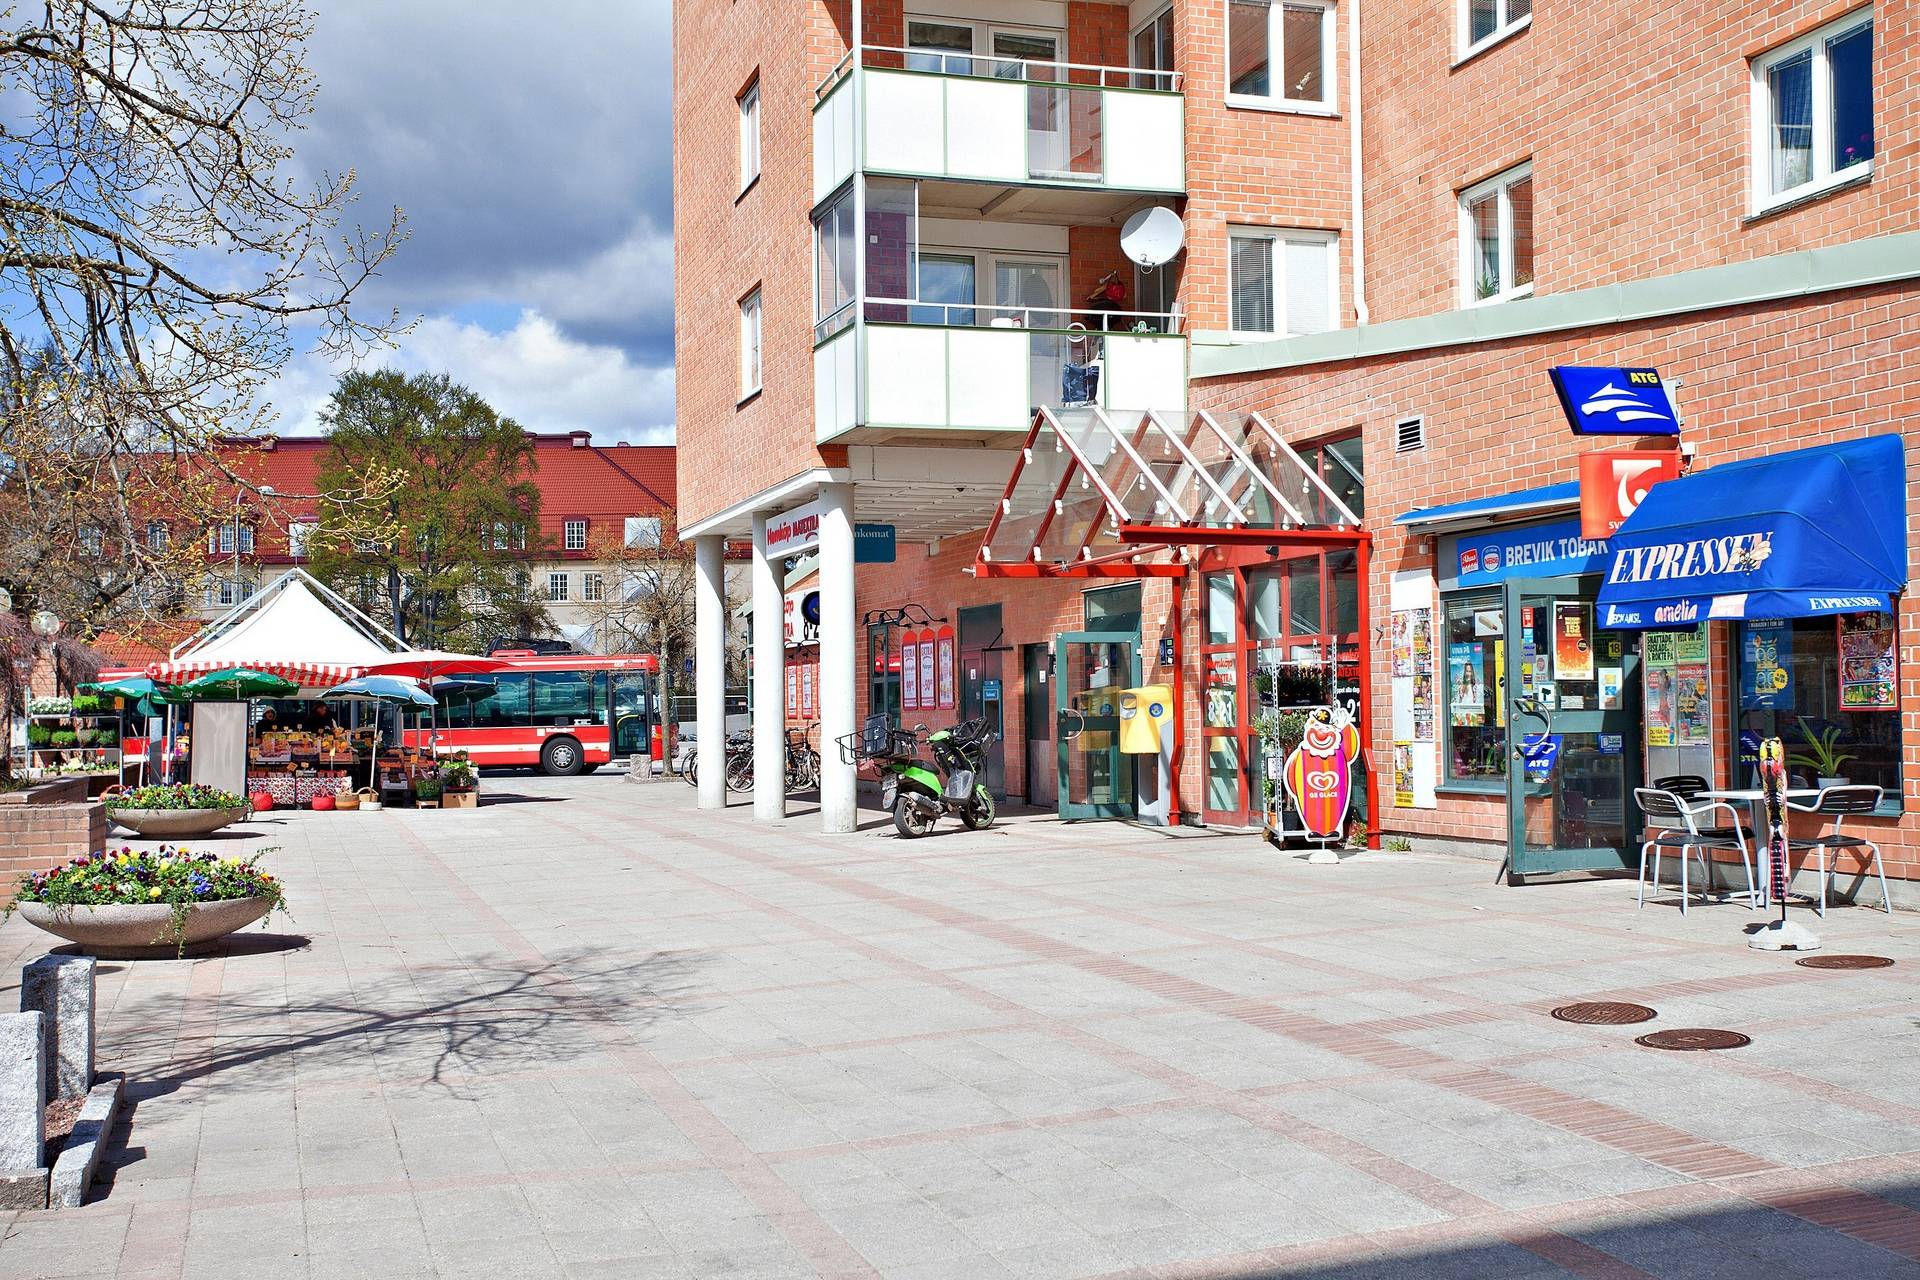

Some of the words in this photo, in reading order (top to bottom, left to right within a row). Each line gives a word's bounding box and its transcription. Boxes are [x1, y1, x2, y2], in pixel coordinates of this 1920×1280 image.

[1630, 372, 1659, 384] ATG
[1505, 541, 1556, 567] BREVIK
[1608, 531, 1774, 585] EXPRESSEN
[1654, 599, 1698, 624] amelia
[1609, 643, 1620, 655] 18
[1528, 759, 1549, 767] ATG
